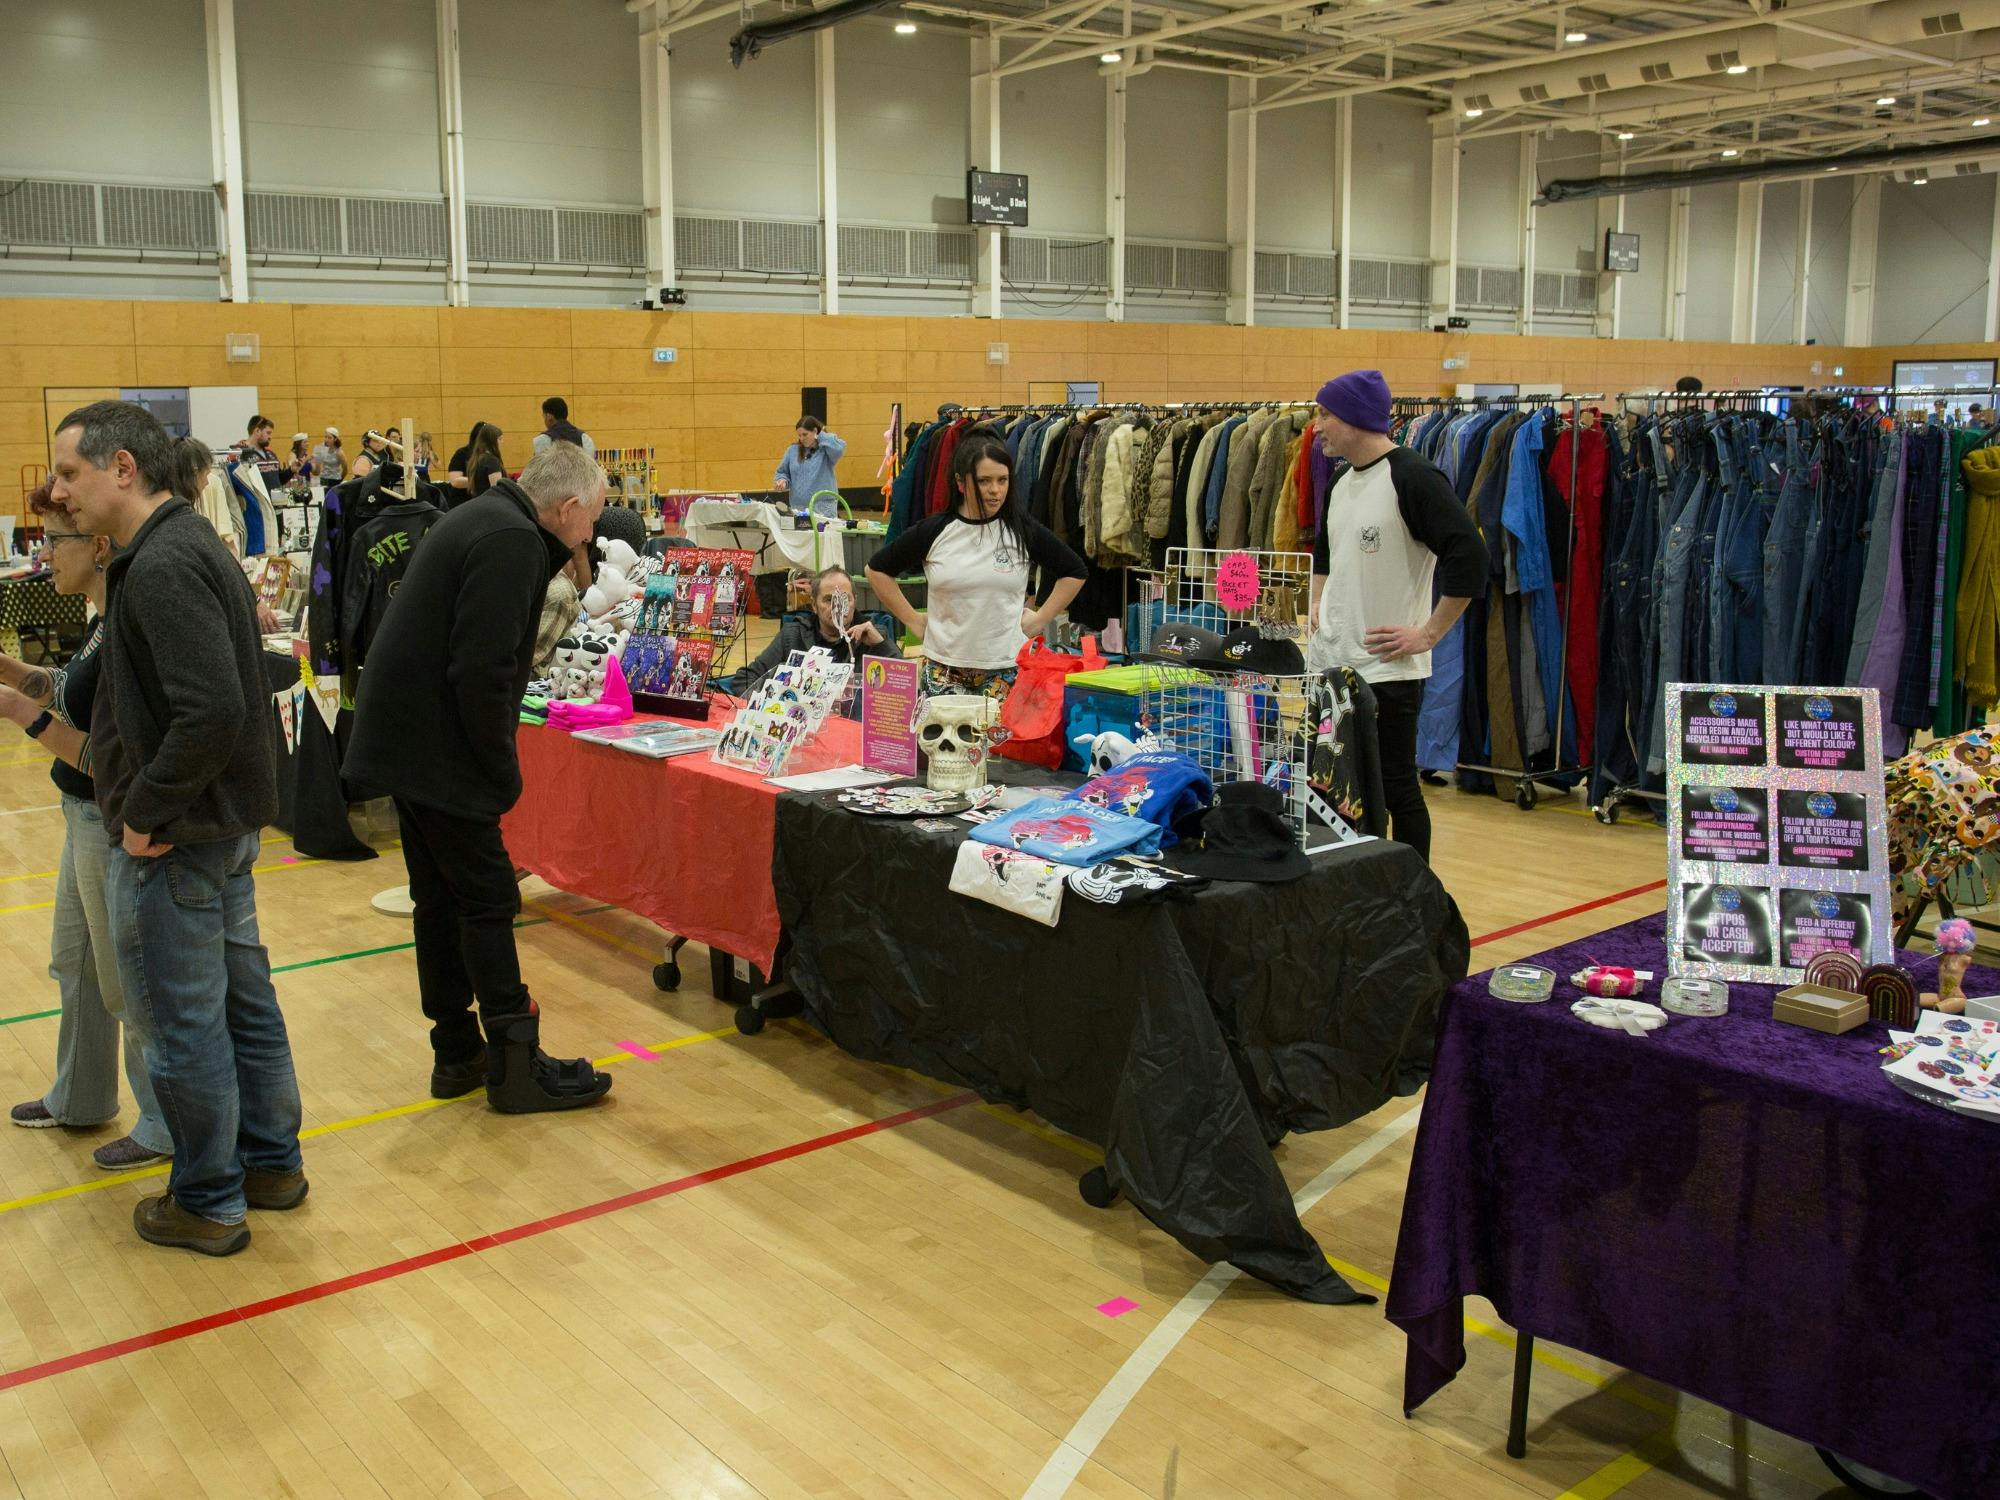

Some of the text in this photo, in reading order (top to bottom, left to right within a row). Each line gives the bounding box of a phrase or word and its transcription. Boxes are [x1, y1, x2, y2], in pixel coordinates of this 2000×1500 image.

[978, 195, 990, 207] Light
[368, 531, 411, 567] BITE
[1690, 717, 1757, 727] ACCESSORIES MADE
[1784, 720, 1799, 729] LIKE
[1801, 721, 1821, 730] WHAT
[1823, 722, 1837, 731] YOU
[1690, 726, 1758, 738] WITH RESIN AND/OR
[1787, 730, 1852, 740] BUT WOULD LIKE A
[1686, 735, 1762, 745] RECYCLED MATERIALS!
[1785, 739, 1856, 749] DIFFERENT COLOUR?
[1795, 749, 1845, 758] CUSTOM ORDERS
[1691, 811, 1713, 819] FOLLOW
[1715, 811, 1723, 820] ON
[1696, 821, 1754, 830] @HAUSOFDYNAMICS
[1782, 817, 1863, 829] FOLLOW ON INSTAGRAM AND
[1689, 829, 1708, 838] CHECK
[1709, 830, 1720, 838] OUT
[1734, 831, 1761, 840] WEBSITE!
[1784, 826, 1801, 834] SHOW
[1803, 827, 1811, 835] ME
[1813, 827, 1820, 835] TO
[1849, 829, 1861, 838] 10%
[1784, 834, 1862, 847] OFF ON TODAY'S PURCHASE!
[1793, 847, 1854, 857] @HAUSOFDYNAMICS
[1795, 917, 1856, 930] NEED A DIFFERENT
[1706, 926, 1748, 940] OR CASH
[1797, 927, 1854, 939] EARRING FIXING?
[1701, 939, 1754, 954] ACCEPTED!
